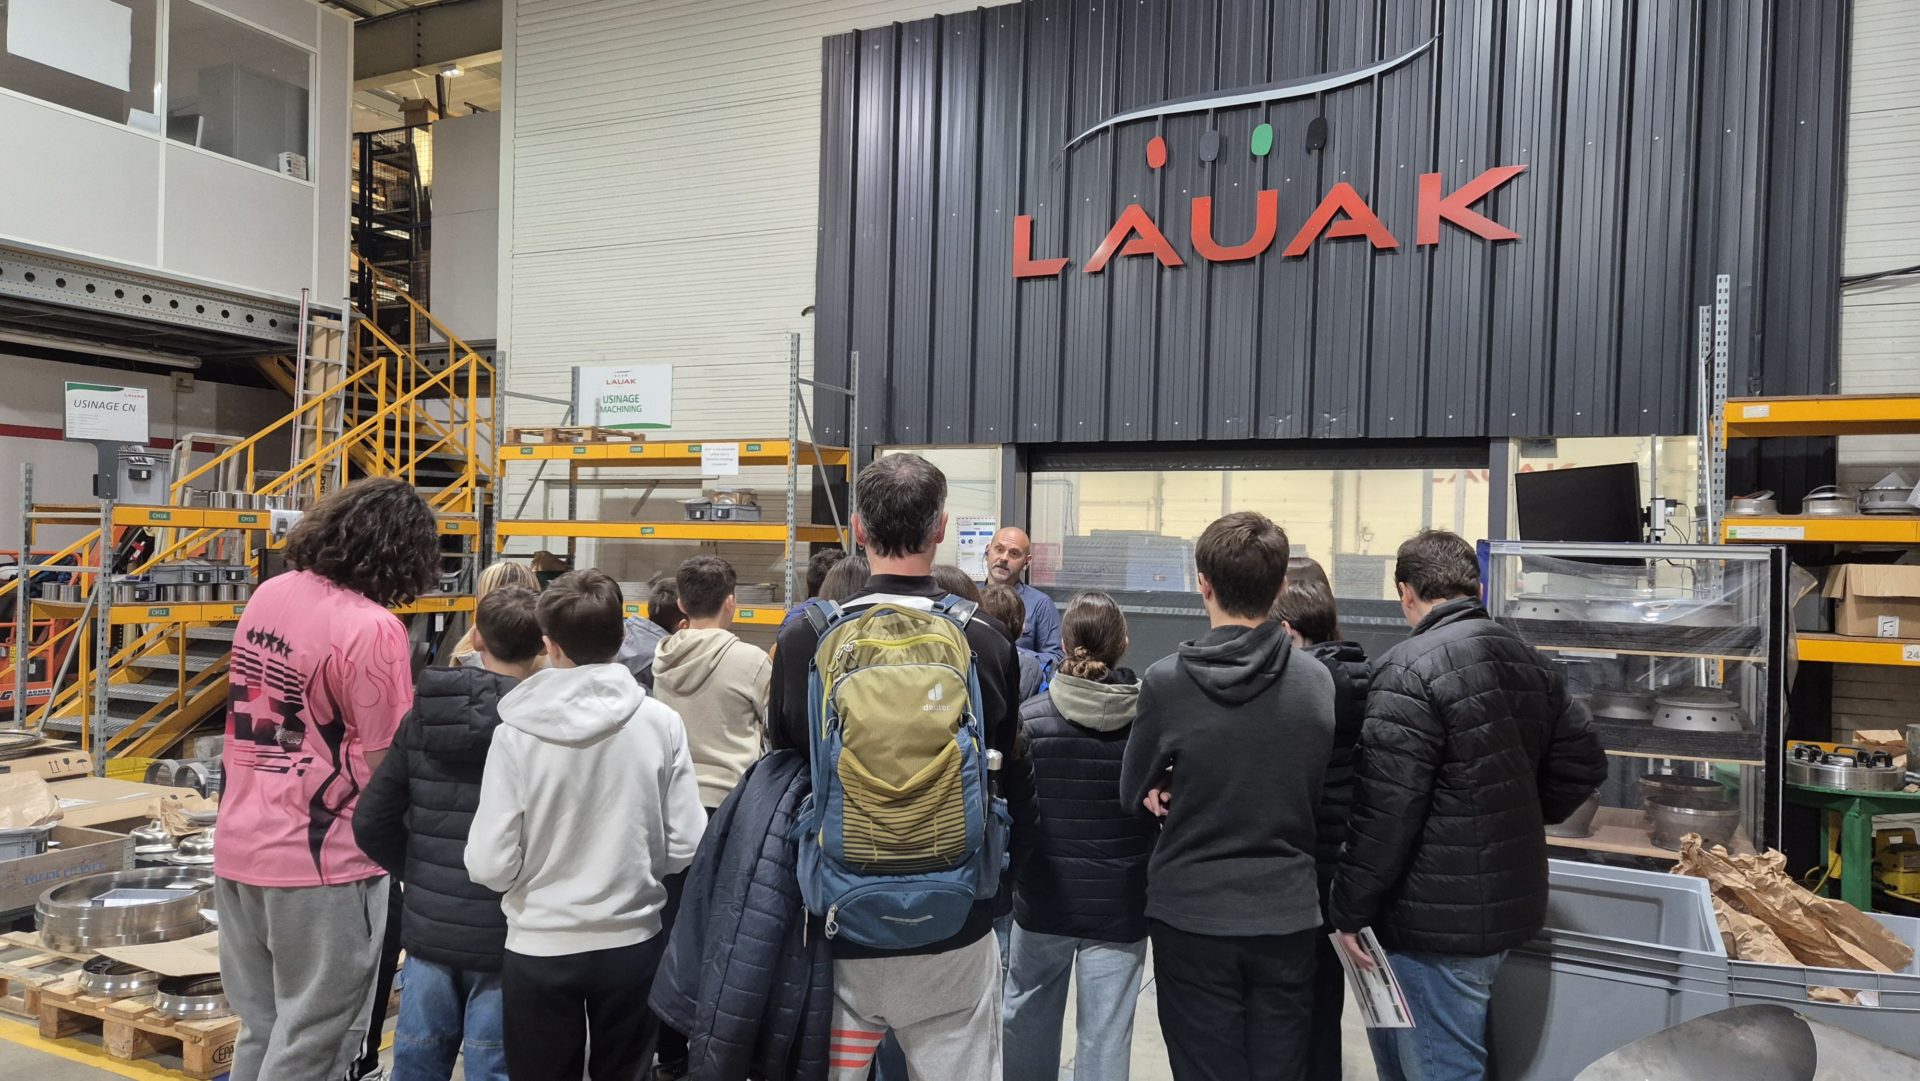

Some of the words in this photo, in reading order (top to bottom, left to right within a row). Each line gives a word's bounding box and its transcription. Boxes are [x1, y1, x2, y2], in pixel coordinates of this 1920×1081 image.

[1012, 164, 1528, 278] LAUAK
[602, 394, 640, 404] USINAGE
[73, 399, 120, 411] USINAGE
[122, 403, 137, 412] CN
[600, 405, 642, 413] MACHINING
